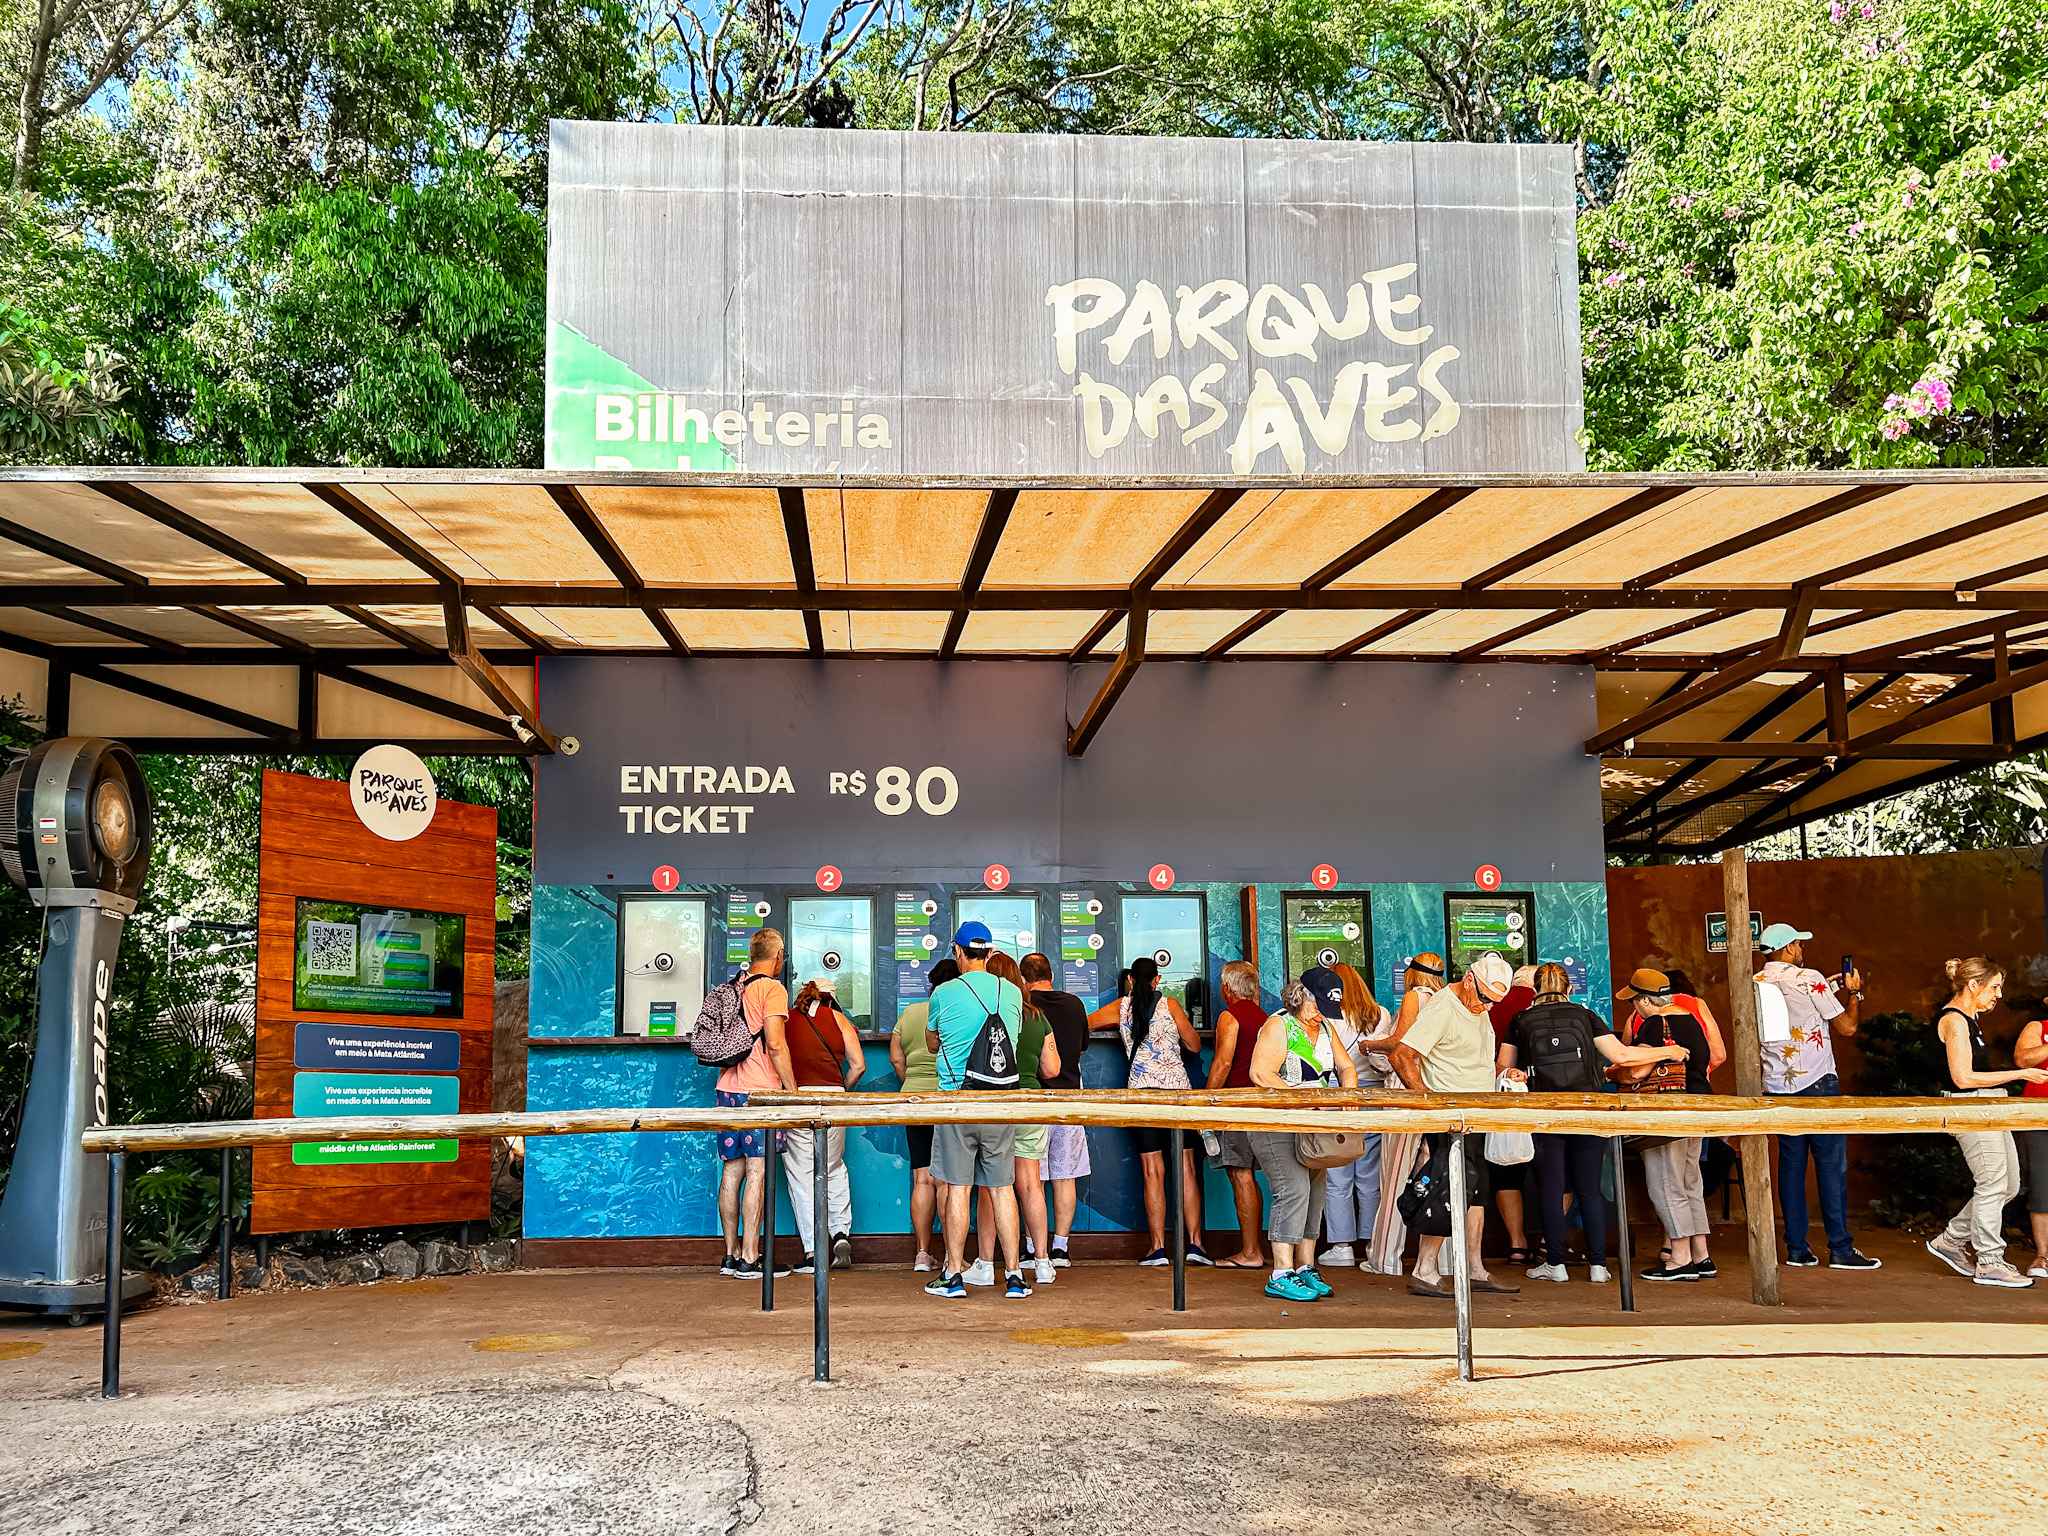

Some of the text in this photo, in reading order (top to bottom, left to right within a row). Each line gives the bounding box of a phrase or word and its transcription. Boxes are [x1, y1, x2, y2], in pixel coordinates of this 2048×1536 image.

[1045, 263, 1434, 374] PARQUE
[1073, 345, 1461, 474] DAS AVES
[595, 395, 892, 449] Bilheteria
[360, 769, 424, 794] PARQUE
[621, 766, 960, 816] ENTRADA R$ 80
[363, 787, 428, 814] DAS AVES
[619, 806, 754, 833] TICKET
[662, 871, 670, 886] 1
[823, 871, 834, 886] 2
[991, 870, 1003, 885] 3
[1156, 870, 1168, 885] 4
[1318, 870, 1330, 885] 5
[1482, 870, 1495, 885] 6
[94, 959, 109, 1127] oape
[327, 1037, 344, 1046] Viva
[363, 1039, 405, 1049] experiência
[406, 1041, 432, 1050] incrível
[348, 1049, 367, 1057] meio
[368, 1049, 373, 1058] à
[374, 1050, 392, 1058] Mata
[393, 1050, 425, 1059] Atlântica
[325, 1086, 342, 1095] Vive
[358, 1087, 401, 1096] experiencia
[402, 1086, 432, 1095] increíble
[337, 1097, 361, 1105] medio
[362, 1097, 371, 1105] de
[372, 1097, 379, 1105] la
[380, 1097, 398, 1105] Mata
[399, 1096, 431, 1105] Atlántica
[319, 1142, 435, 1153] middle of the Atlantic Rainforest
